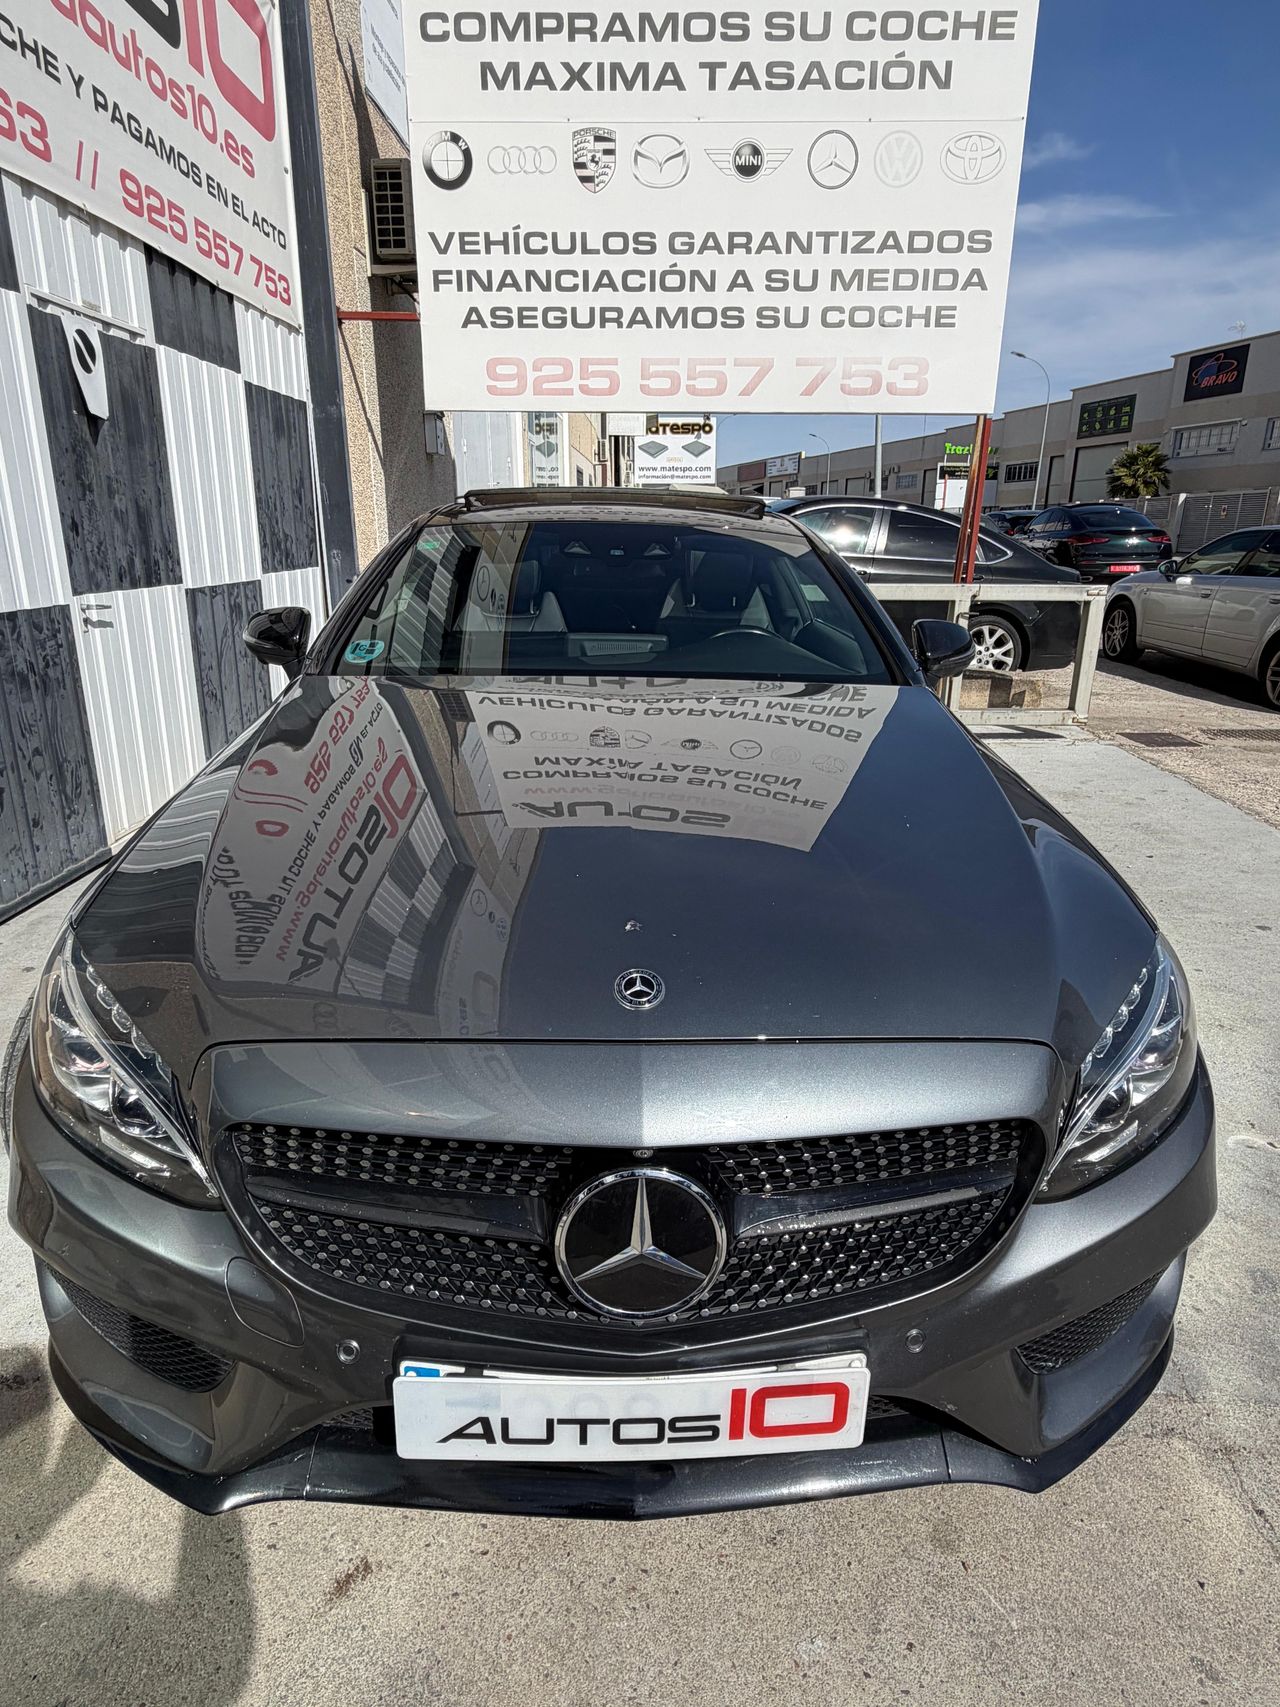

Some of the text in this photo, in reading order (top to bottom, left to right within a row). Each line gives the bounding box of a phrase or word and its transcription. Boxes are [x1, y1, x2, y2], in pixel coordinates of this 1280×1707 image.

[419, 10, 1018, 43] COMPRAMOS SU COCHE
[480, 50, 953, 92] MAXIMA TASACIÓN
[573, 127, 615, 138] PORSCHE
[66, 64, 85, 100] Y
[92, 83, 203, 188] PAGAMOS
[206, 173, 229, 209] EN
[232, 193, 249, 223] EL
[252, 210, 287, 250] ACTO
[734, 154, 761, 167] MINI
[120, 168, 188, 245] 925
[194, 216, 243, 275] 557
[250, 254, 291, 306] 753
[428, 224, 992, 255] VEHÍCULOS GARANTIZADOS
[432, 262, 988, 293] FINANCIACIÓN A SU MEDIDA
[461, 305, 957, 329] ASEGURAMOS SU COCHE
[485, 357, 929, 396] 925 557 753
[1200, 370, 1238, 388] BRAVO
[638, 465, 712, 473] www.matespo.com
[435, 1381, 851, 1446] AUTOS10
